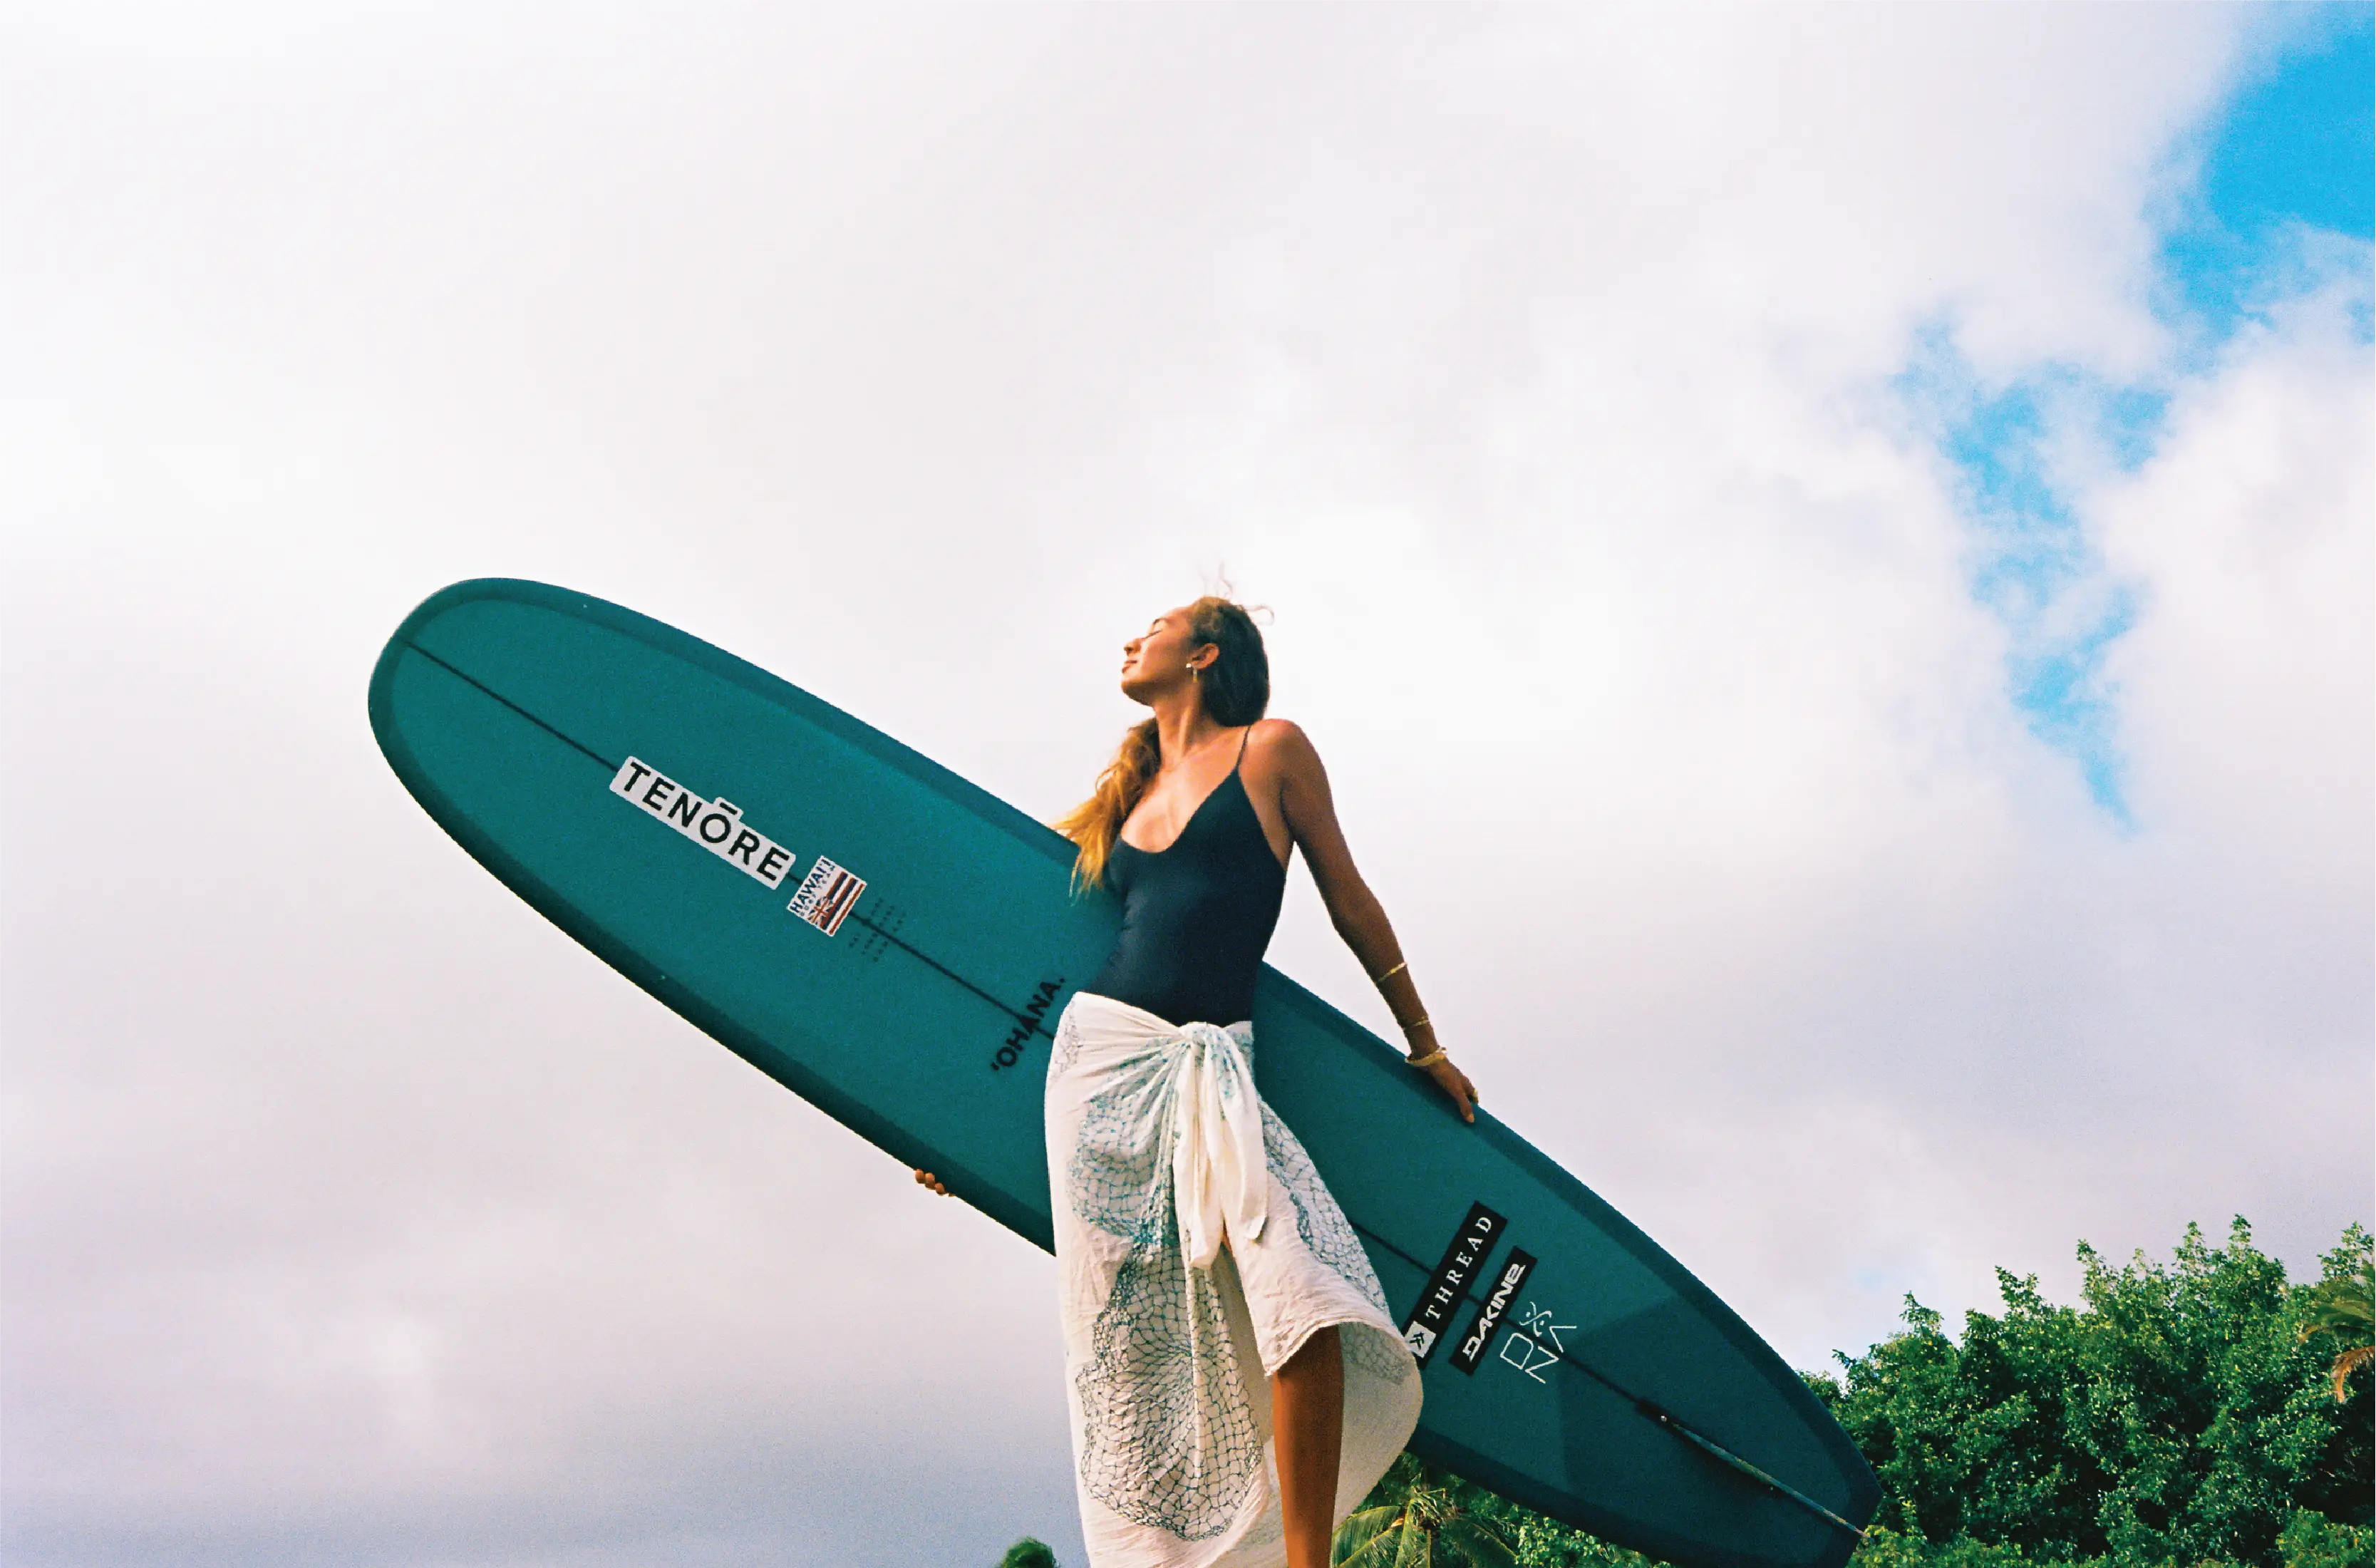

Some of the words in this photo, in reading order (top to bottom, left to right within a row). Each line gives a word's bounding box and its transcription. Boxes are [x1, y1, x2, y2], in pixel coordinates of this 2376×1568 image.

[623, 762, 790, 882] TENŌRE
[1425, 1215, 1493, 1321] THREAD
[1462, 1262, 1526, 1362] DAKINE
